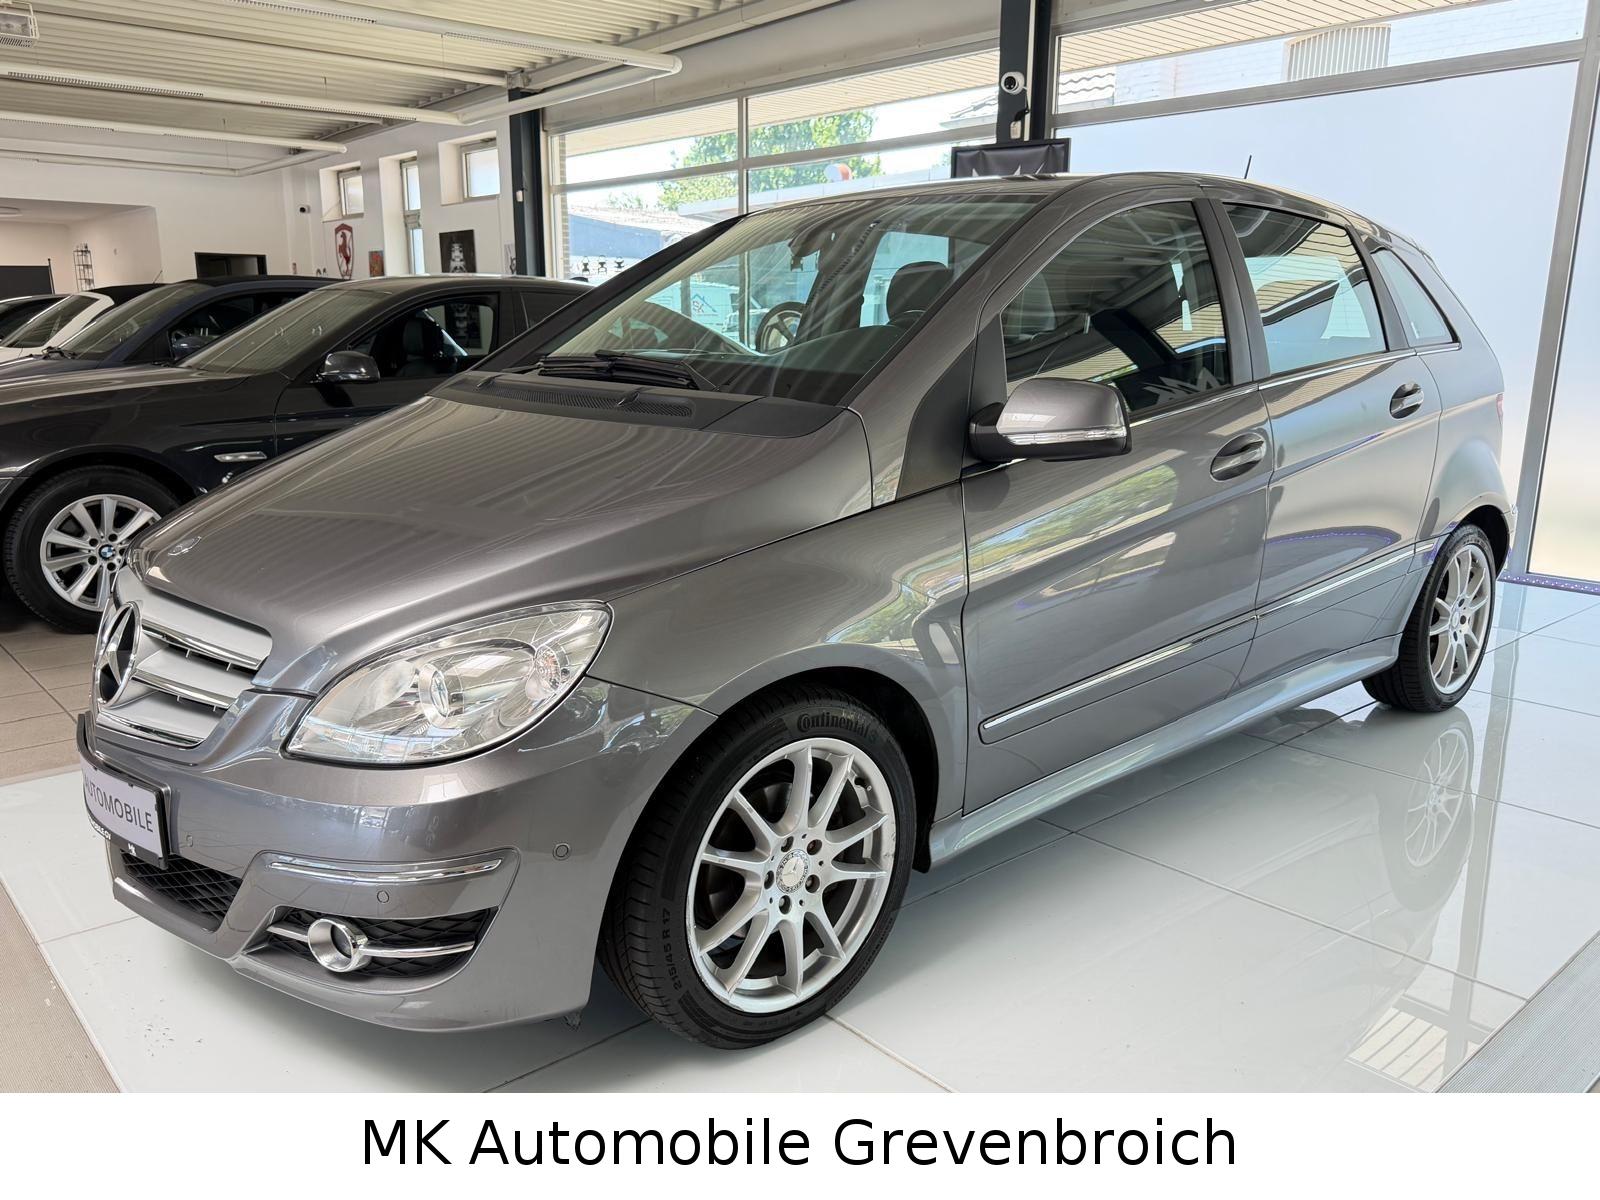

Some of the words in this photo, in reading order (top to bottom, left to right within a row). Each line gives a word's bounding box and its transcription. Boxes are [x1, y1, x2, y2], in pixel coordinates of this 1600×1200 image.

[797, 711, 871, 738] Continental
[662, 907, 671, 925] 17
[662, 928, 671, 940] R
[663, 942, 682, 990] 215/45
